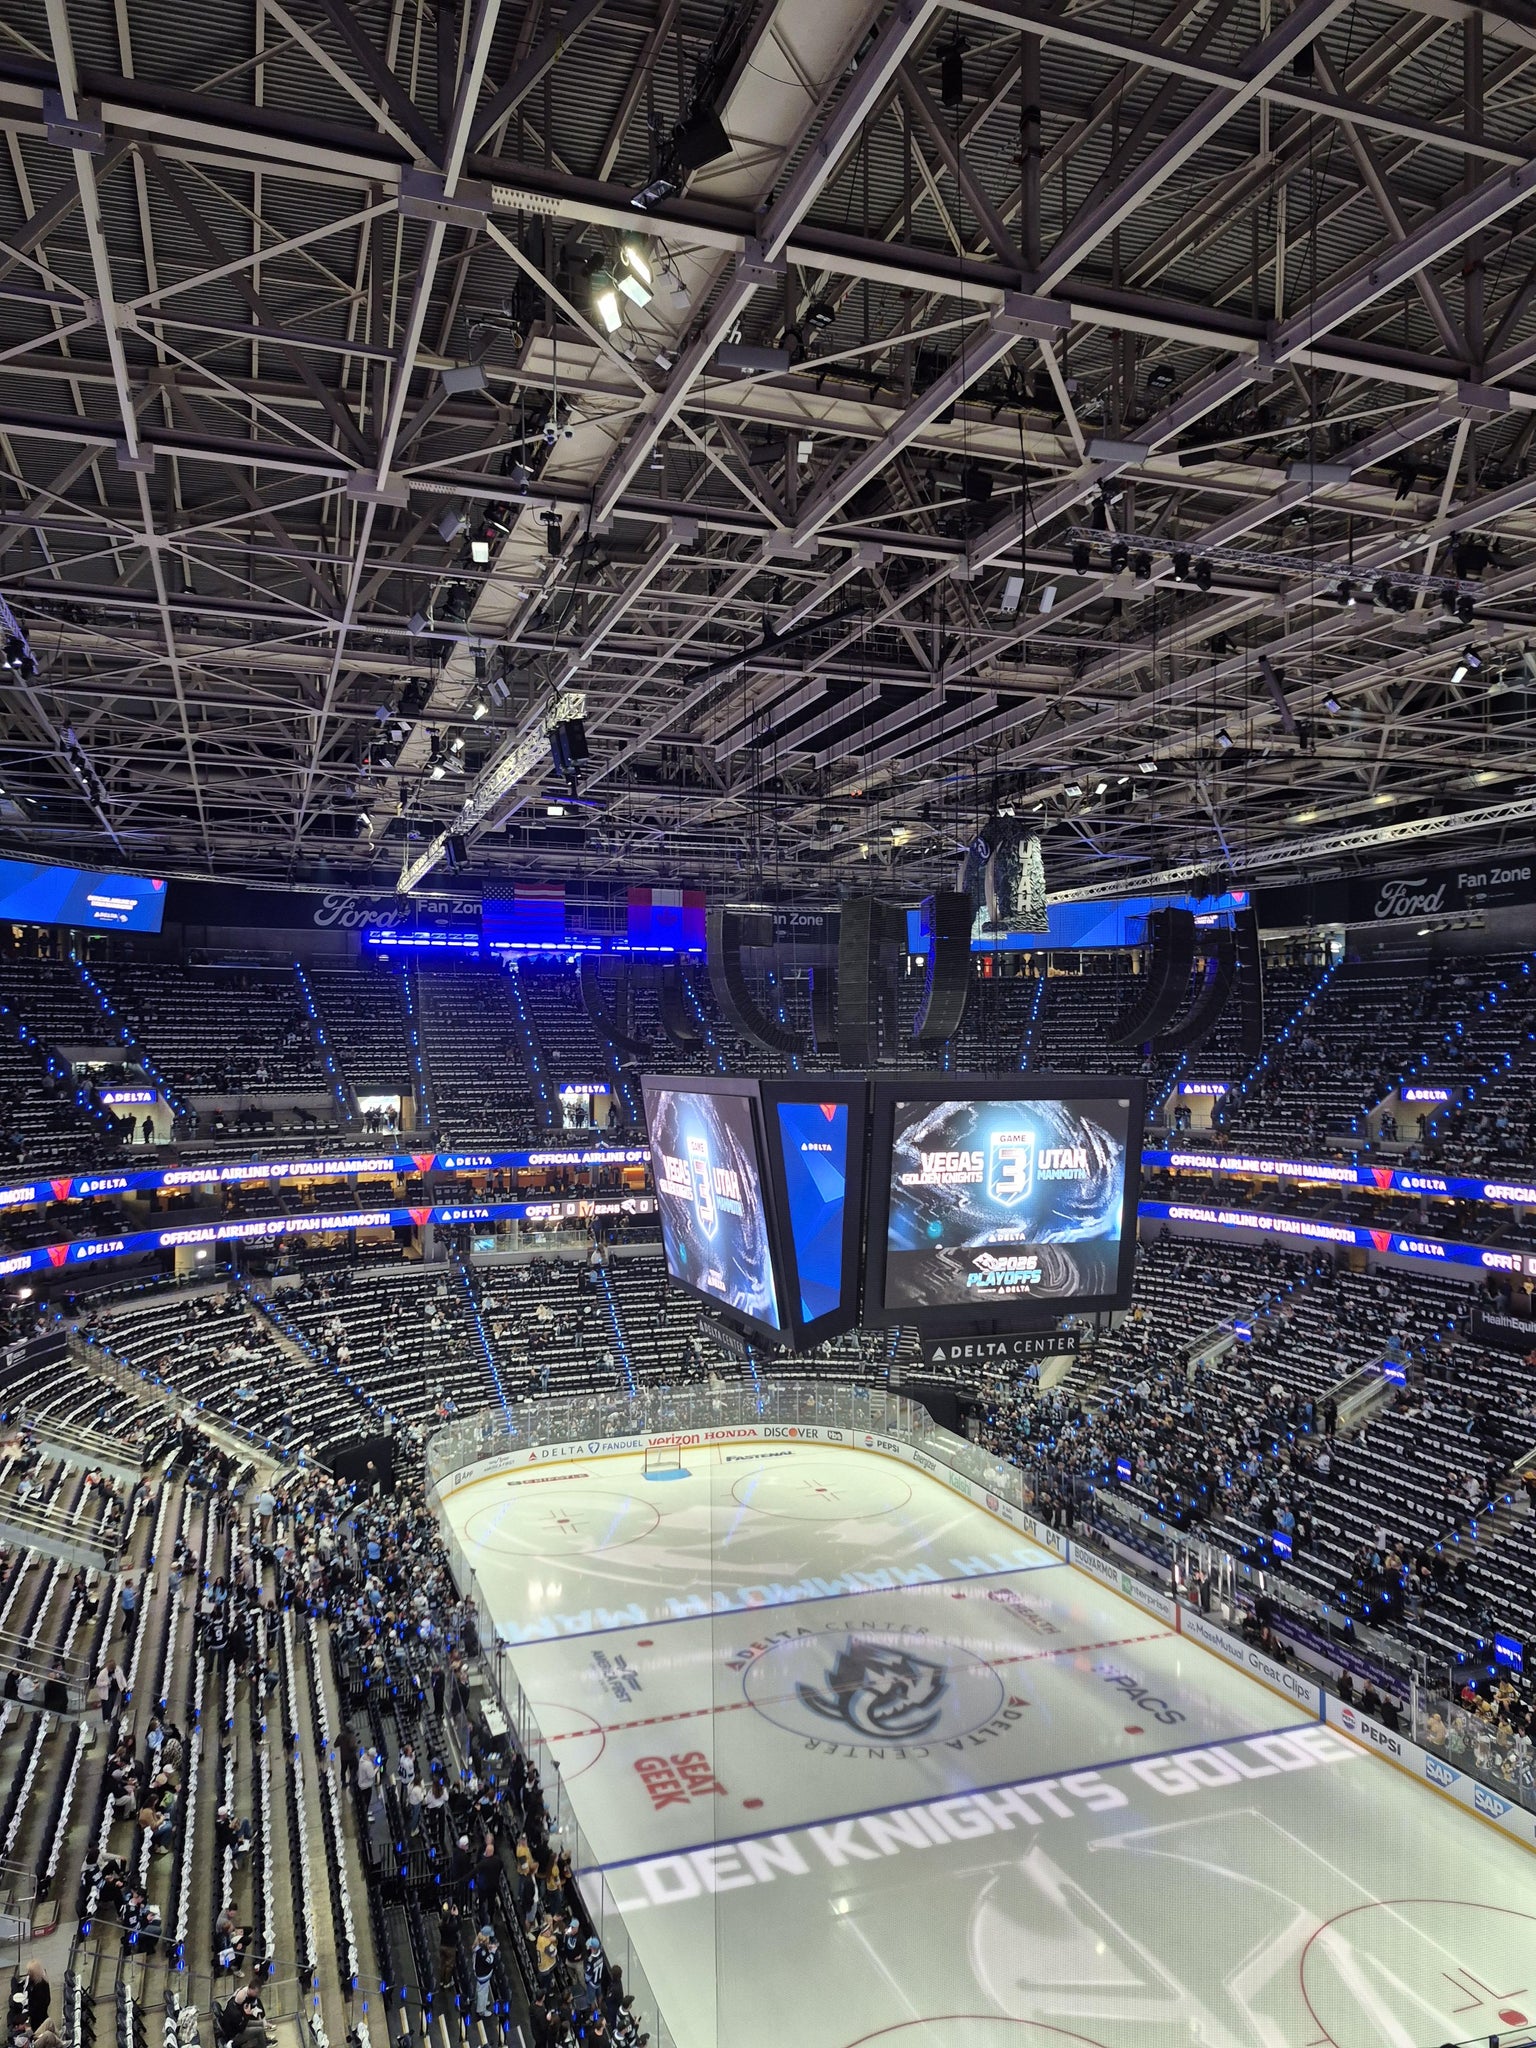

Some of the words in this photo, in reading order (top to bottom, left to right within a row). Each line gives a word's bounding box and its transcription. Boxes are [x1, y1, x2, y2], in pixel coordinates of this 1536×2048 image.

[1018, 840, 1033, 912] UTAH
[1458, 873, 1487, 888] Fan
[1490, 867, 1531, 884] Zone
[418, 900, 448, 913] Fan
[452, 900, 483, 915] Zon
[1374, 878, 1446, 917] Ford
[314, 894, 400, 928] Ford
[773, 915, 787, 925] an
[790, 913, 823, 926] Zone
[115, 1092, 152, 1102] DELTA
[575, 1085, 605, 1093] DELTA
[1193, 1084, 1226, 1094] DELTA
[1415, 1089, 1448, 1100] DELTA
[808, 1143, 833, 1151] DELTA
[1000, 1134, 1027, 1142] GAME
[456, 1156, 492, 1166] DELTA
[529, 1154, 581, 1165] OFFICIAL
[582, 1152, 625, 1163] AIRLINE
[626, 1151, 644, 1162] OF
[164, 1170, 220, 1185] OFFICIAL
[220, 1166, 270, 1181] AIRLINE
[271, 1165, 288, 1176] OF
[290, 1162, 324, 1174] UTAH
[325, 1159, 393, 1173] MAMMOTH
[902, 1173, 941, 1185] GOLDEN
[941, 1171, 983, 1184] KNIGHTS
[920, 1152, 985, 1172] VEGAS
[996, 1148, 1027, 1193] 3
[1038, 1149, 1087, 1169] UTAH
[1037, 1169, 1086, 1180] MAMMOTH
[1171, 1155, 1219, 1168] OFFICIAL
[1220, 1158, 1259, 1173] AIRLINE
[1260, 1163, 1274, 1173] OF
[1275, 1163, 1301, 1176] UTAH
[1302, 1165, 1357, 1182] MAMMOTH
[91, 1178, 127, 1191] DELTA
[713, 1167, 742, 1202] UTAH
[1411, 1178, 1447, 1191] DELTA
[453, 1209, 489, 1219] DELTA
[566, 1203, 576, 1215] 0
[640, 1200, 649, 1212] 0
[160, 1229, 216, 1245] OFFICIAL
[217, 1224, 266, 1239] AIRLINE
[267, 1223, 285, 1234] OF
[286, 1218, 320, 1232] UTAH
[321, 1213, 390, 1229] MAMMOTH
[1169, 1207, 1217, 1222] OFFICIAL
[1218, 1211, 1258, 1227] AIRLINE
[1259, 1217, 1273, 1229] OF
[1273, 1218, 1300, 1234] UTAH
[1301, 1221, 1356, 1243] MAMMOTH
[998, 1233, 1026, 1241] DELTA
[88, 1241, 124, 1255] DELTA
[1409, 1240, 1445, 1256] DELTA
[997, 1255, 1038, 1271] 2026
[967, 1270, 1042, 1287] PLAYOFFS
[722, 1333, 745, 1354] CENTER
[951, 1343, 1007, 1359] DELTA
[1013, 1337, 1075, 1354] CENTER
[648, 1432, 700, 1446] verizon
[704, 1429, 758, 1440] HONDA
[764, 1427, 819, 1439] DISCOVER
[542, 1446, 585, 1458] DELTA
[602, 1439, 643, 1451] FANDUEL
[876, 1440, 900, 1453] PEPSI
[912, 1451, 937, 1471] Energizer
[950, 1474, 972, 1497] Kalshi
[1023, 1516, 1037, 1537] CAT
[1046, 1530, 1061, 1552] CAT
[1074, 1545, 1119, 1584] BODYARMOR
[740, 1626, 813, 1660] DELTA
[825, 1620, 929, 1635] CENTER
[1195, 1623, 1244, 1661] MassMutual
[1249, 1651, 1281, 1683] Great
[1282, 1674, 1310, 1701] Clips
[1104, 1675, 1186, 1725] PACS
[946, 1709, 1022, 1751] DELTA
[1361, 1722, 1401, 1757] PEPSI
[804, 1737, 929, 1760] CENTER
[670, 1751, 729, 1797] SEAT
[1426, 1758, 1454, 1786] SAP
[634, 1756, 691, 1811] GEEK
[1474, 1789, 1504, 1817] SAP
[808, 1770, 1130, 1867] KNIGHTS
